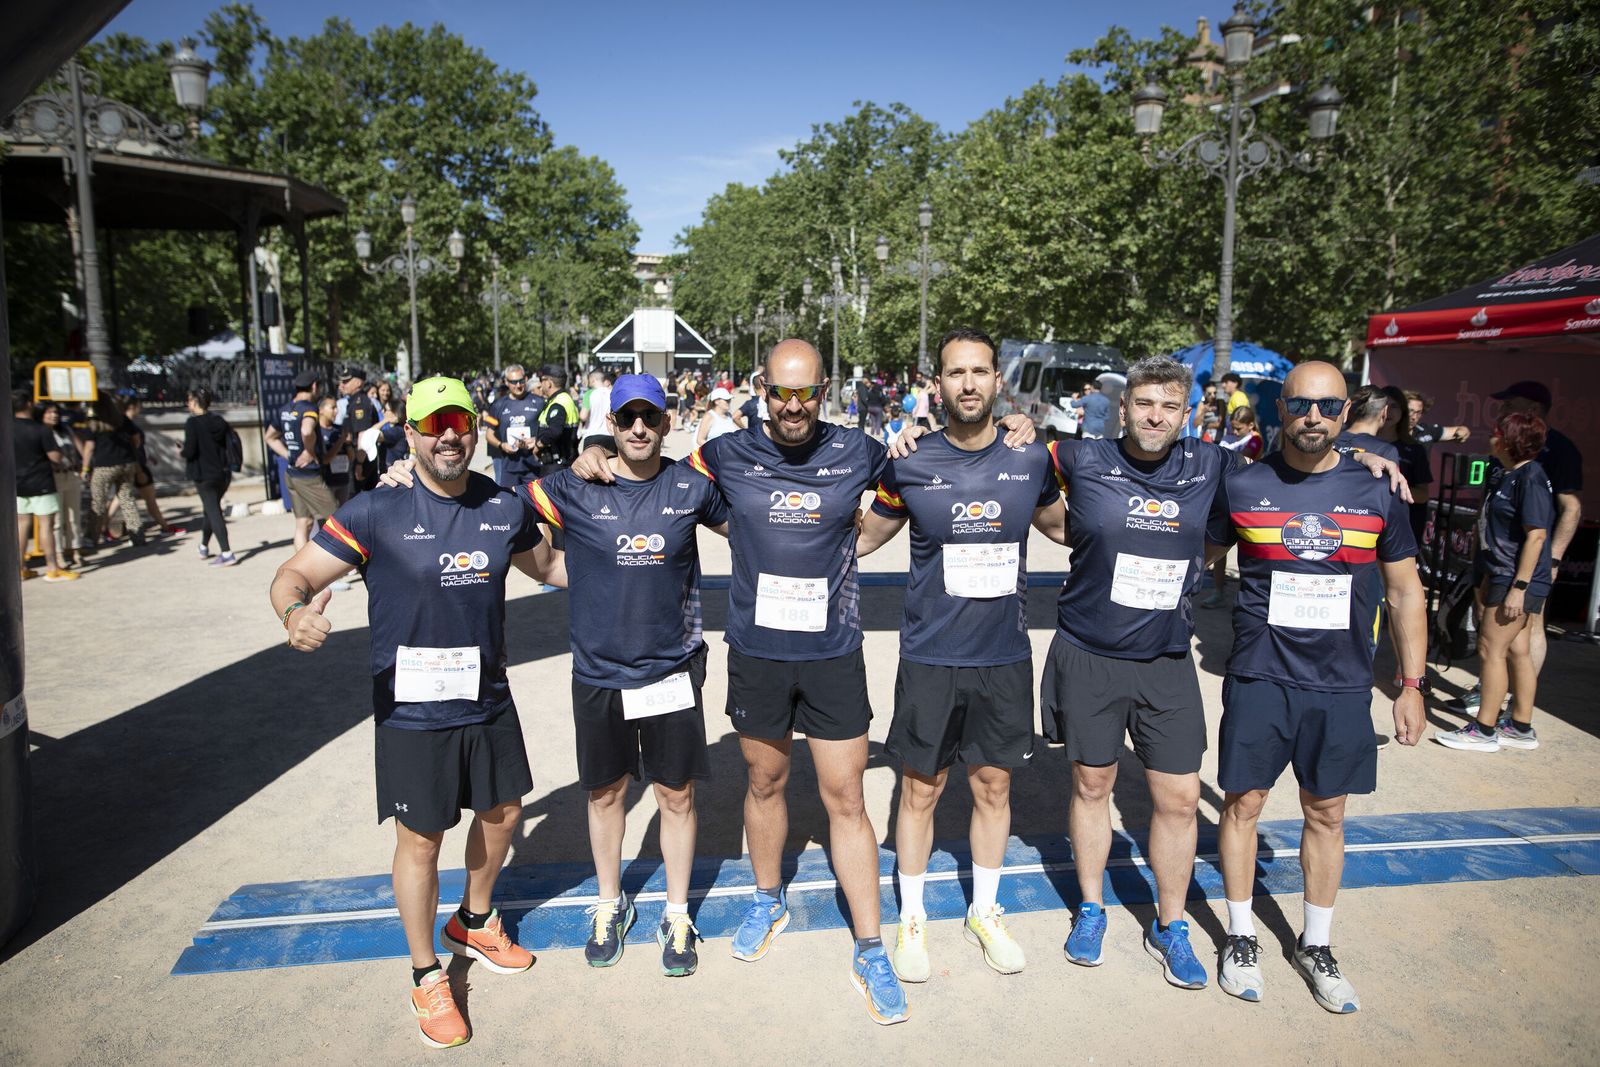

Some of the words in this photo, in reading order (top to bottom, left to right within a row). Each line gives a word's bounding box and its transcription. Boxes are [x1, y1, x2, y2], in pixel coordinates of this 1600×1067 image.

[1456, 326, 1503, 340] Santander
[831, 466, 852, 476] mupol
[1011, 473, 1030, 482] mupol
[924, 483, 952, 491] Santander
[769, 511, 810, 519] POLICIA
[1347, 507, 1369, 515] mupol
[591, 513, 619, 521] Santander
[769, 517, 821, 525] NACIONAL
[1126, 516, 1169, 527] POLICIA
[492, 523, 511, 532] mupol
[952, 521, 992, 529] POLICIA
[1125, 522, 1179, 533] NACIONAL
[952, 527, 1002, 535] NACIONAL
[403, 533, 436, 541] Santander
[1285, 538, 1315, 546] RUTA
[1319, 539, 1340, 547] 091
[440, 573, 481, 582] POLICIA
[441, 578, 489, 588] NACIONAL
[1275, 583, 1296, 592] alsa
[778, 607, 809, 622] 188
[1294, 604, 1330, 620] 806
[434, 679, 446, 693] 3
[645, 690, 677, 707] 835
